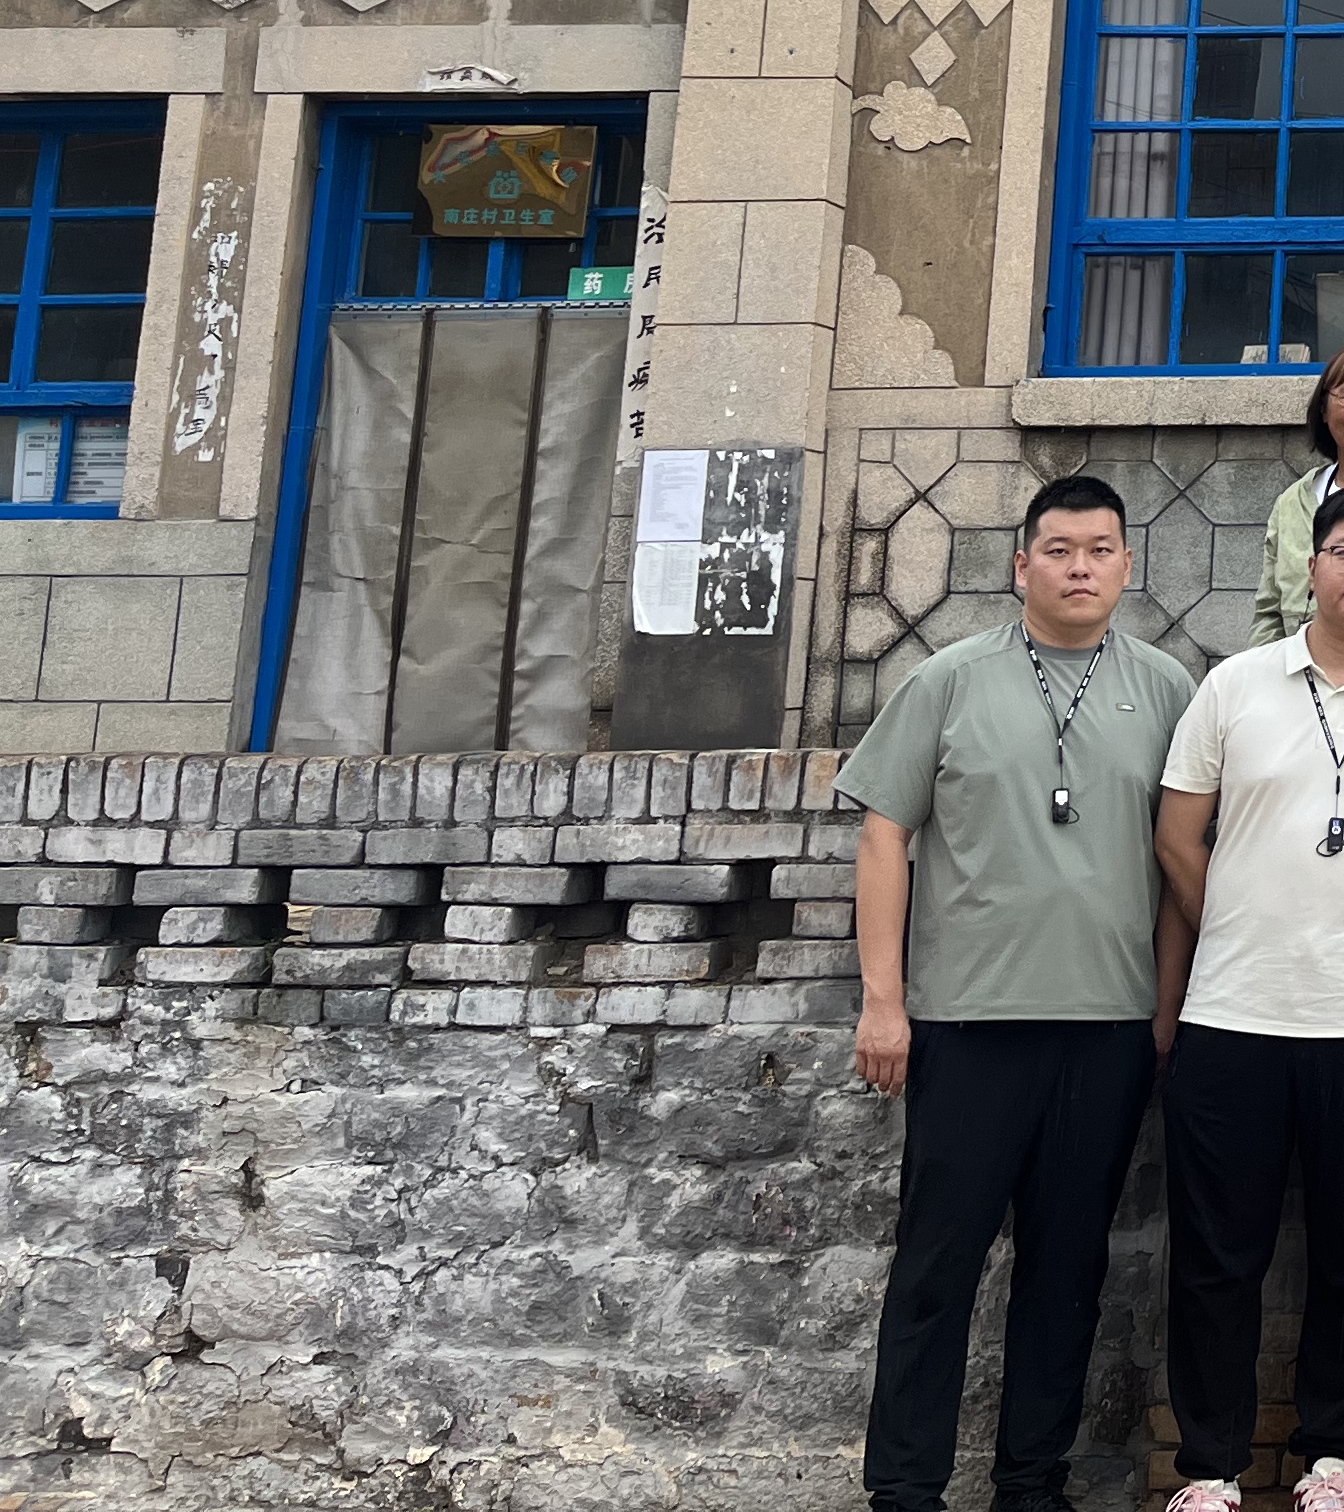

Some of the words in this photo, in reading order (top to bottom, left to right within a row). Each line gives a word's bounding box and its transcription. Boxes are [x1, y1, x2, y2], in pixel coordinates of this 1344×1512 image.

[444, 208, 555, 225] 南庄村卫生室
